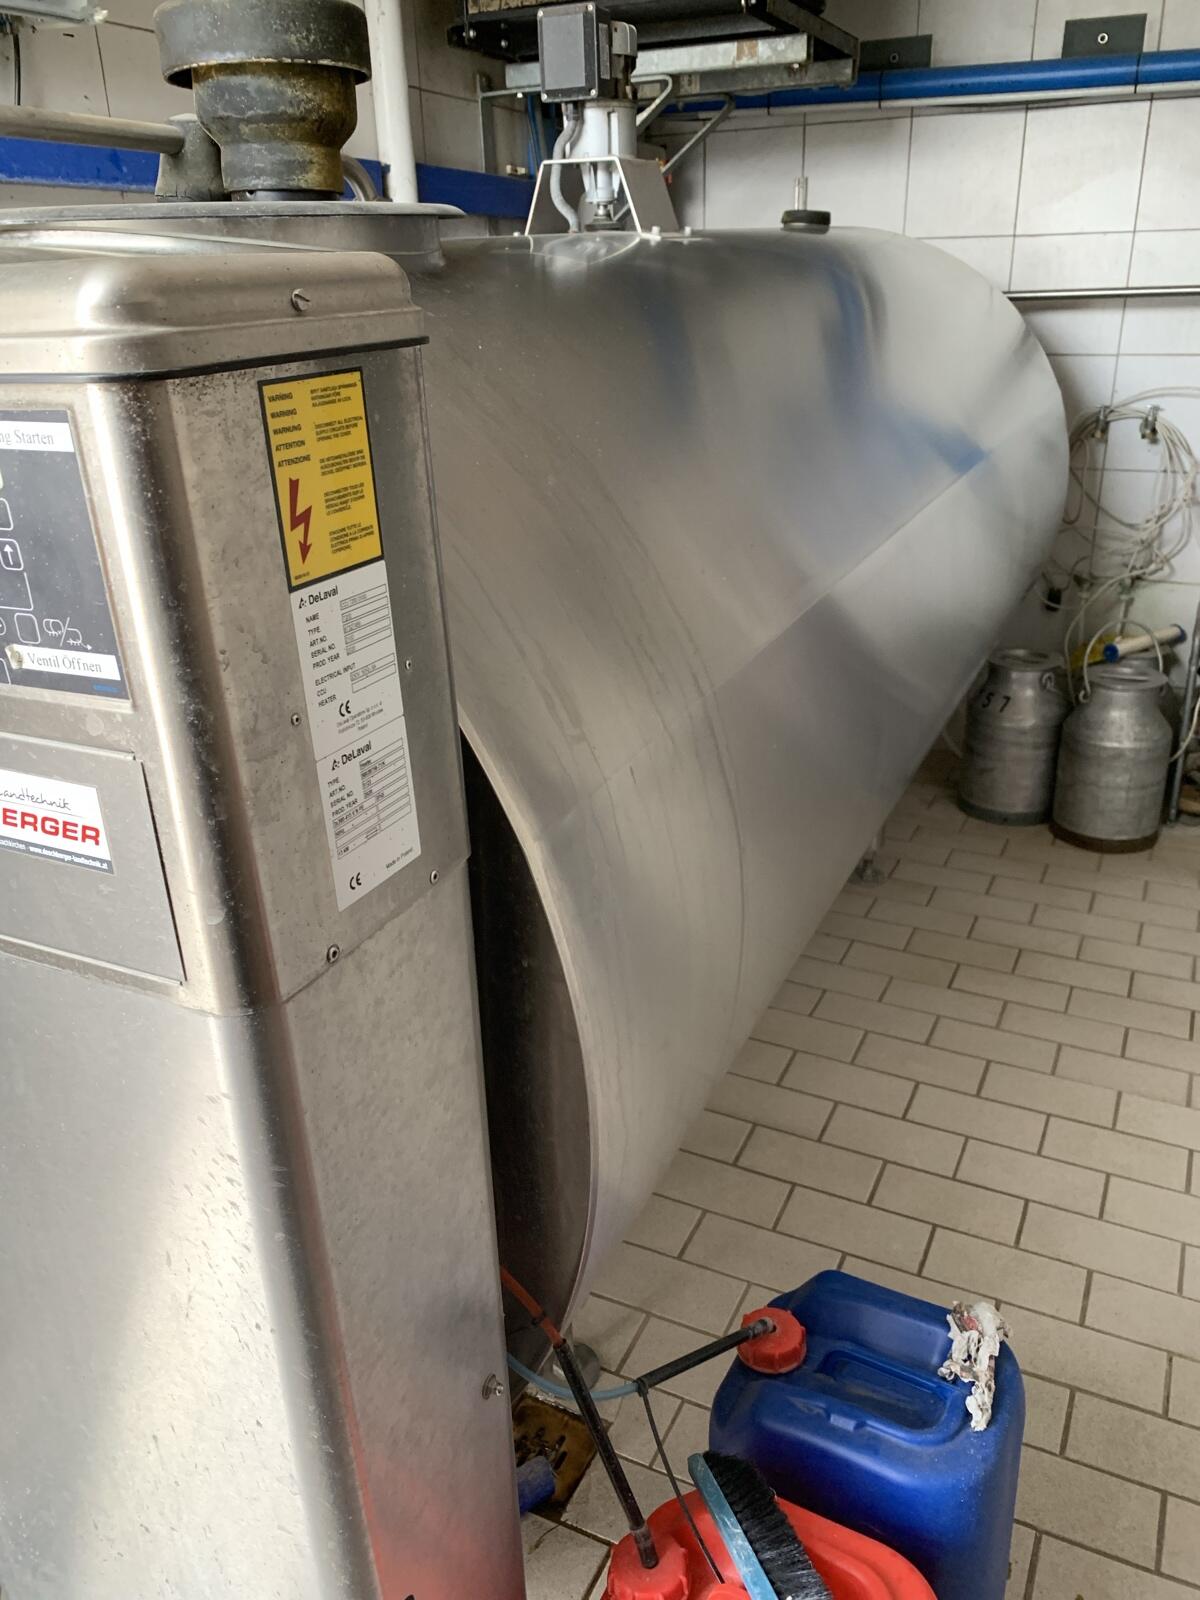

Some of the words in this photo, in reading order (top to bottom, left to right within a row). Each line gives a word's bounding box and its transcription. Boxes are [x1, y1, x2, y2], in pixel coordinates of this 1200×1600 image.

[270, 408, 297, 418] WARNING
[272, 423, 302, 435] WARNUNG
[14, 429, 55, 446] Starten
[275, 439, 305, 451] ATTENTION
[277, 454, 310, 467] ATTENZIONE
[308, 585, 339, 606] DeLaval
[306, 612, 319, 623] NAME
[308, 626, 320, 636] TYPE
[27, 652, 60, 669] Ventil
[315, 670, 342, 686] ELECTRICAL
[343, 662, 356, 672] INPUT
[318, 694, 336, 707] HEATER
[341, 740, 371, 765] DeLaval
[3, 807, 100, 846] ERGER
